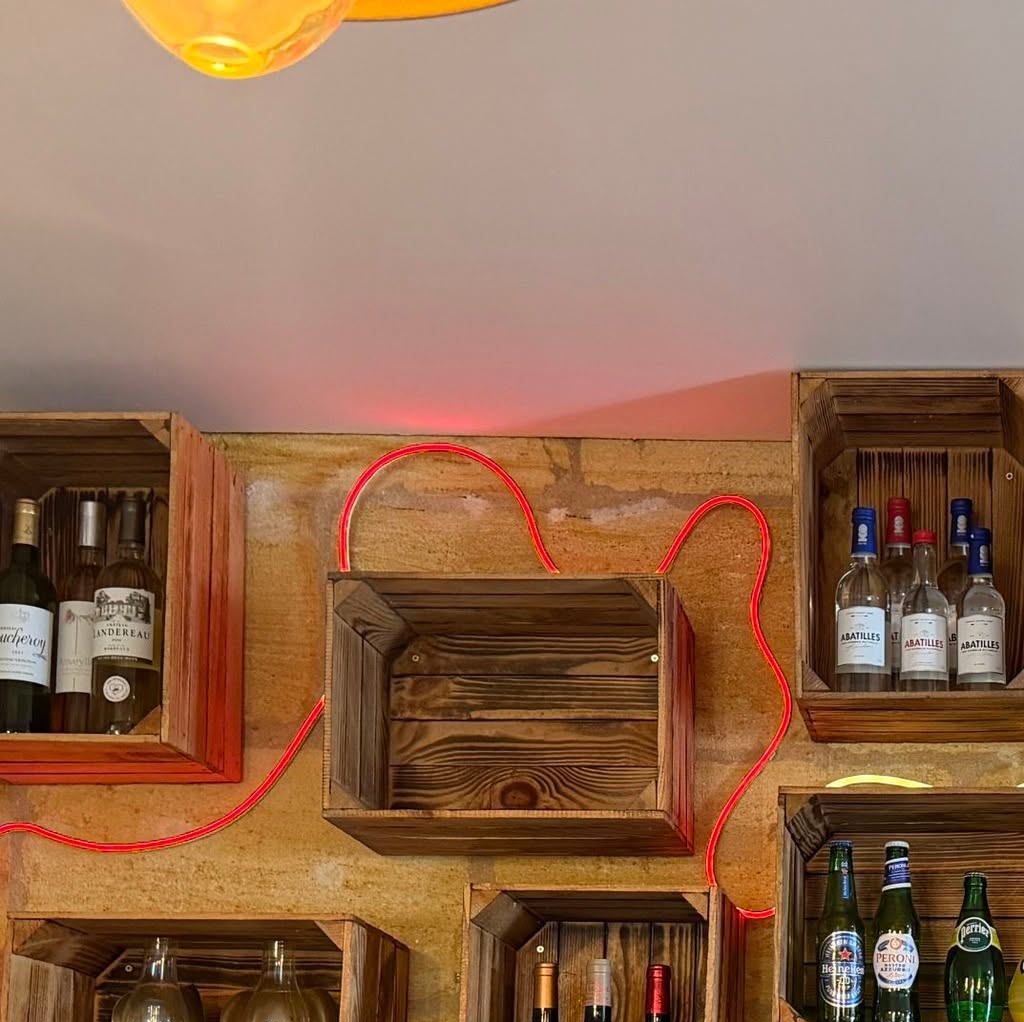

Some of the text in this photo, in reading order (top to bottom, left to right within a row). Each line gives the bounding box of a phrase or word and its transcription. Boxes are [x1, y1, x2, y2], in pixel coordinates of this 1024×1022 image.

[840, 631, 881, 642] ABATILLES
[904, 638, 944, 649] ABATILLES
[960, 639, 1000, 650] ABATILLES
[960, 922, 990, 944] Perrier
[876, 953, 915, 964] PERONI
